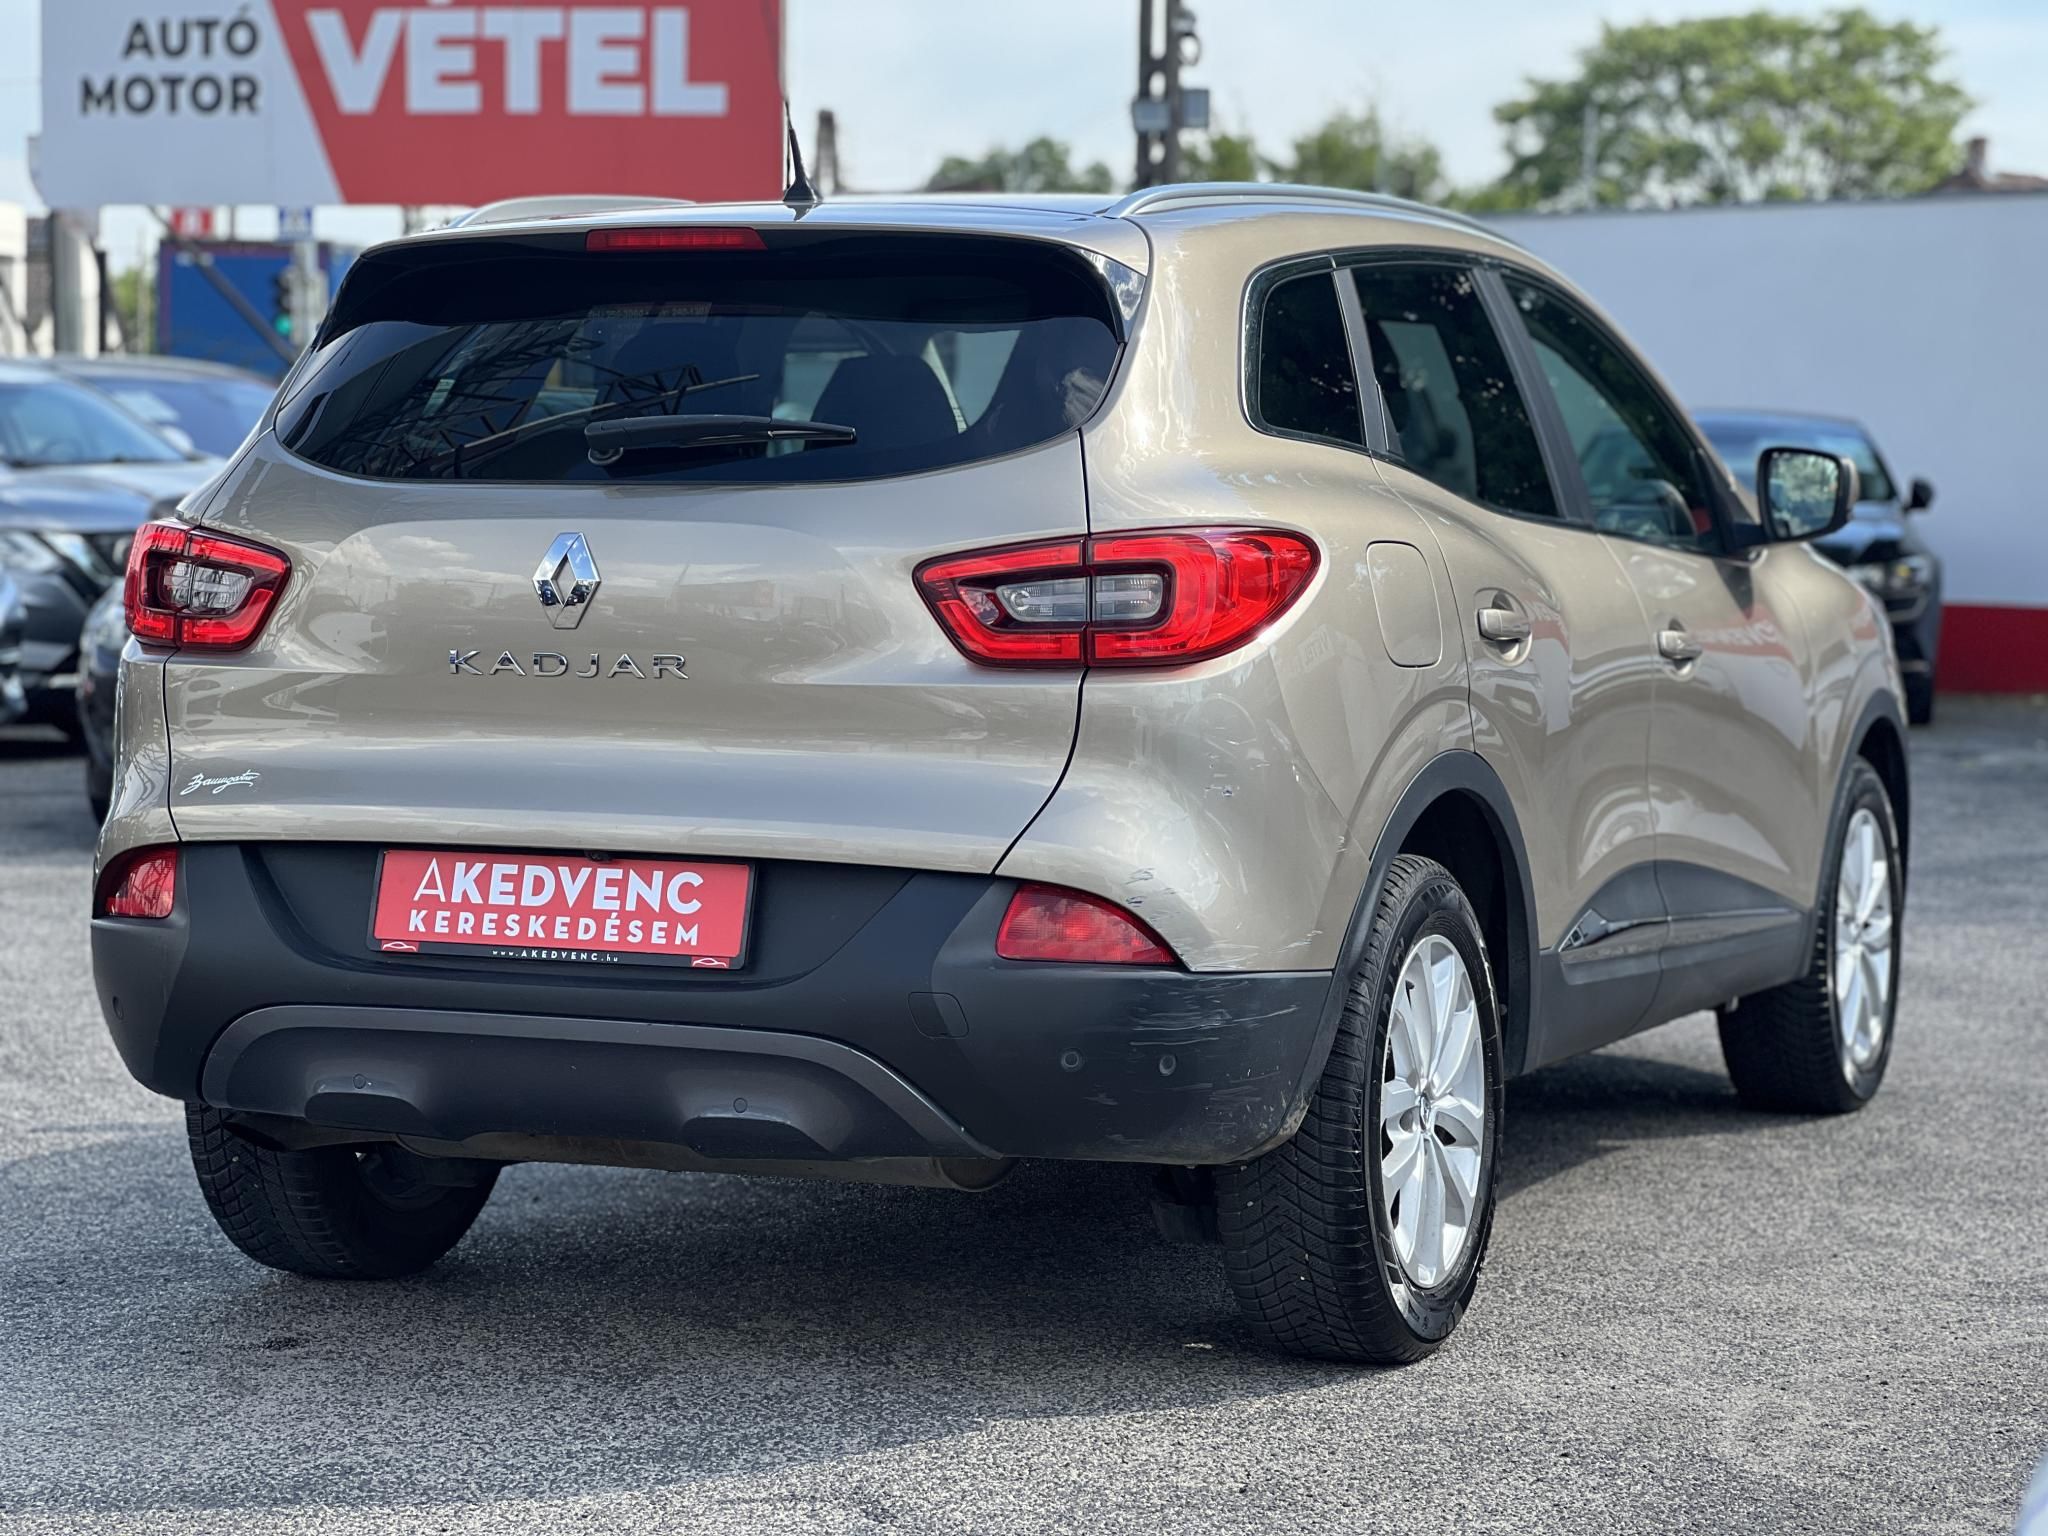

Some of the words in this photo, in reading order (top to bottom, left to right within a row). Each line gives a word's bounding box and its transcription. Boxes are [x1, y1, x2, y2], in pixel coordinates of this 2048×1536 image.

[122, 4, 259, 60] AUTÓ
[306, 0, 729, 116] VÉTEL
[80, 74, 259, 115] MOTOR
[449, 649, 689, 680] KADJAR
[408, 910, 699, 947] KERESKEDÉSEM
[492, 949, 619, 963] www.AKEDVENC.hu
